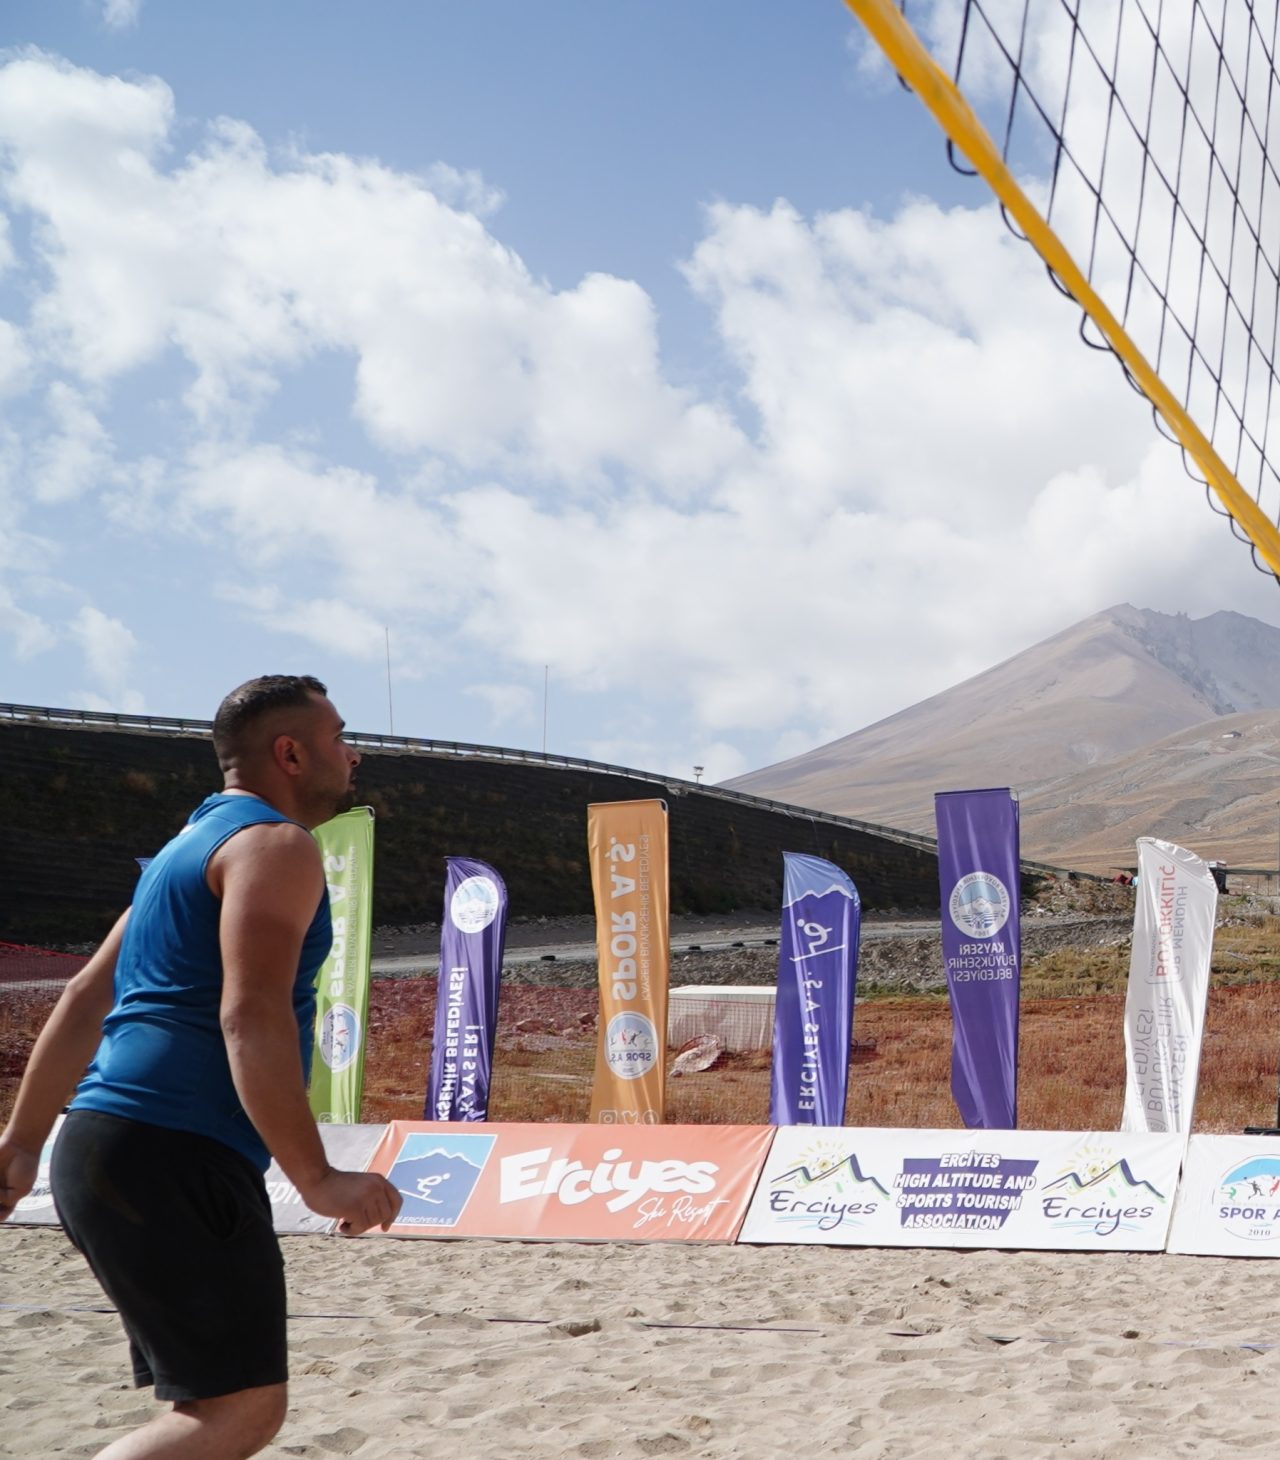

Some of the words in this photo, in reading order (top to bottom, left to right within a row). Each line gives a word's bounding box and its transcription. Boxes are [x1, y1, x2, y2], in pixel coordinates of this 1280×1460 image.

[940, 1150, 1001, 1168] ERCİYES
[500, 1147, 719, 1213] Erciyes
[894, 1173, 931, 1188] HIGH
[932, 1173, 1003, 1189] ALTITUDE
[1003, 1175, 1036, 1190] AND
[896, 1193, 953, 1208] SPORTS
[955, 1194, 1022, 1210] TOURISM
[633, 1196, 666, 1228] Ski
[770, 1190, 878, 1231] Erciyes
[1042, 1197, 1154, 1236] Erciyes
[1219, 1206, 1266, 1220] SPOR
[903, 1213, 1002, 1230] ASSOCIATION
[1248, 1228, 1271, 1236] 2010
